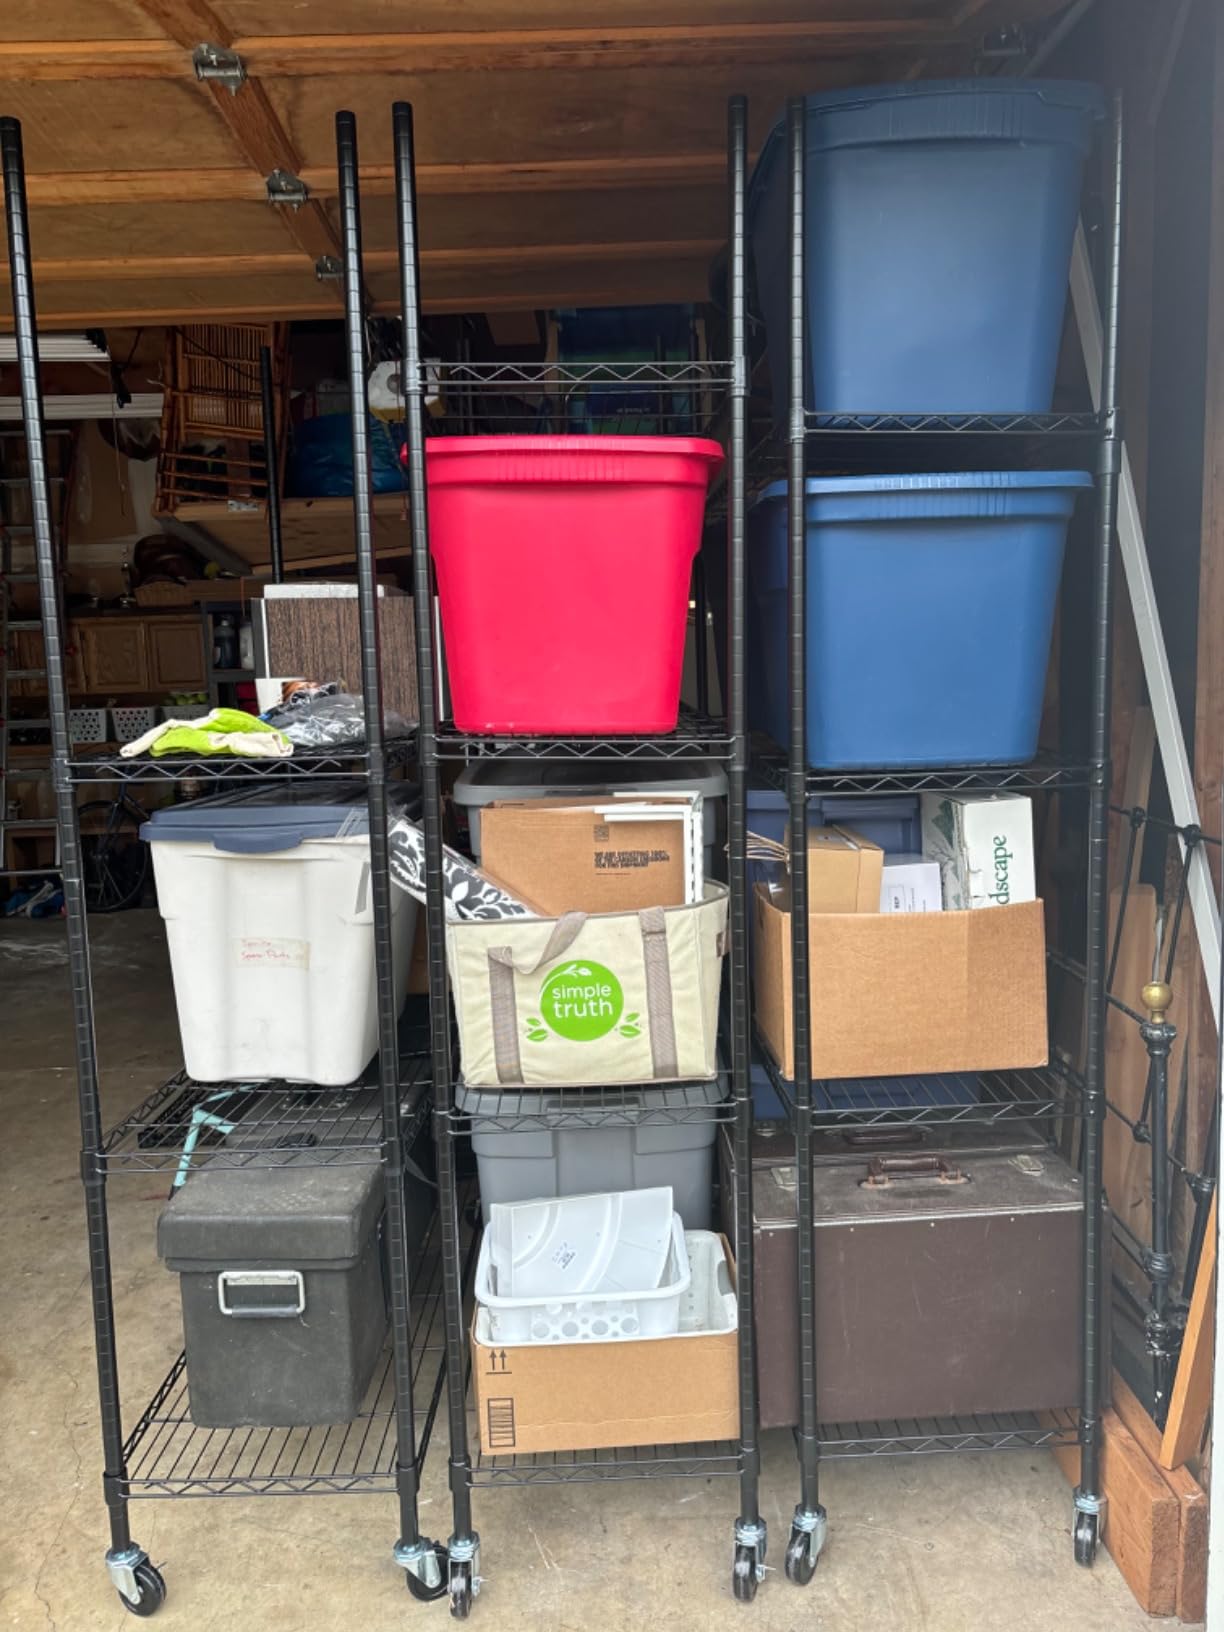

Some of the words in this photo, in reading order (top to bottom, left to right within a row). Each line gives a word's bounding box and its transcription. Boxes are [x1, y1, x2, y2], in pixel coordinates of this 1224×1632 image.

[988, 835, 1013, 905] dscape
[552, 983, 612, 1000] simple
[553, 998, 613, 1018] truth
